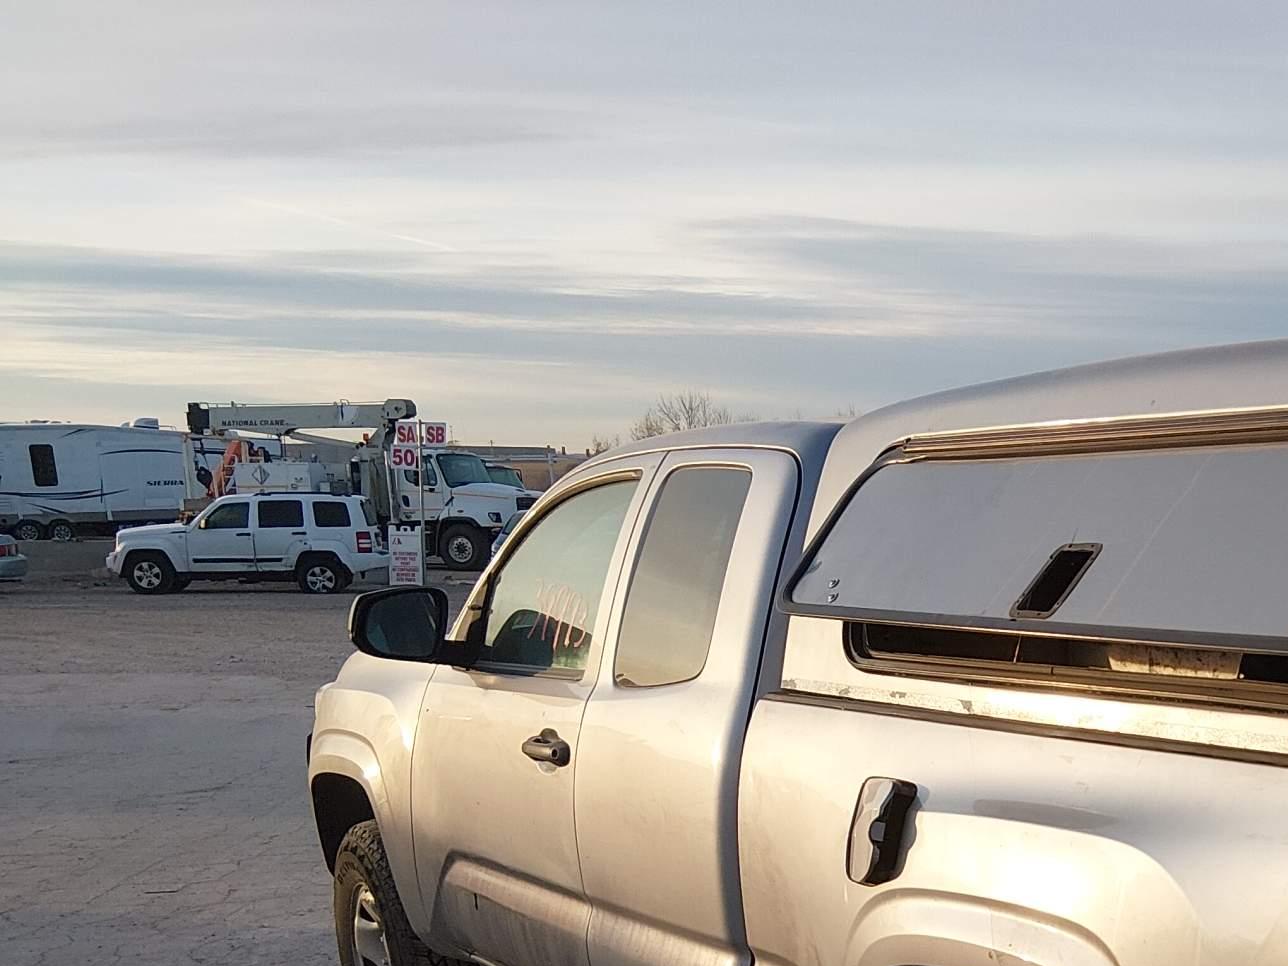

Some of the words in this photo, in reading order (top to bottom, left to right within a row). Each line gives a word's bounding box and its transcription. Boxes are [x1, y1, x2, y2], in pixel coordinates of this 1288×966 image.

[221, 419, 258, 427] NATIONAL
[259, 418, 285, 427] CRANE
[397, 425, 416, 443] SA
[426, 425, 445, 443] SB
[392, 448, 415, 467] 50
